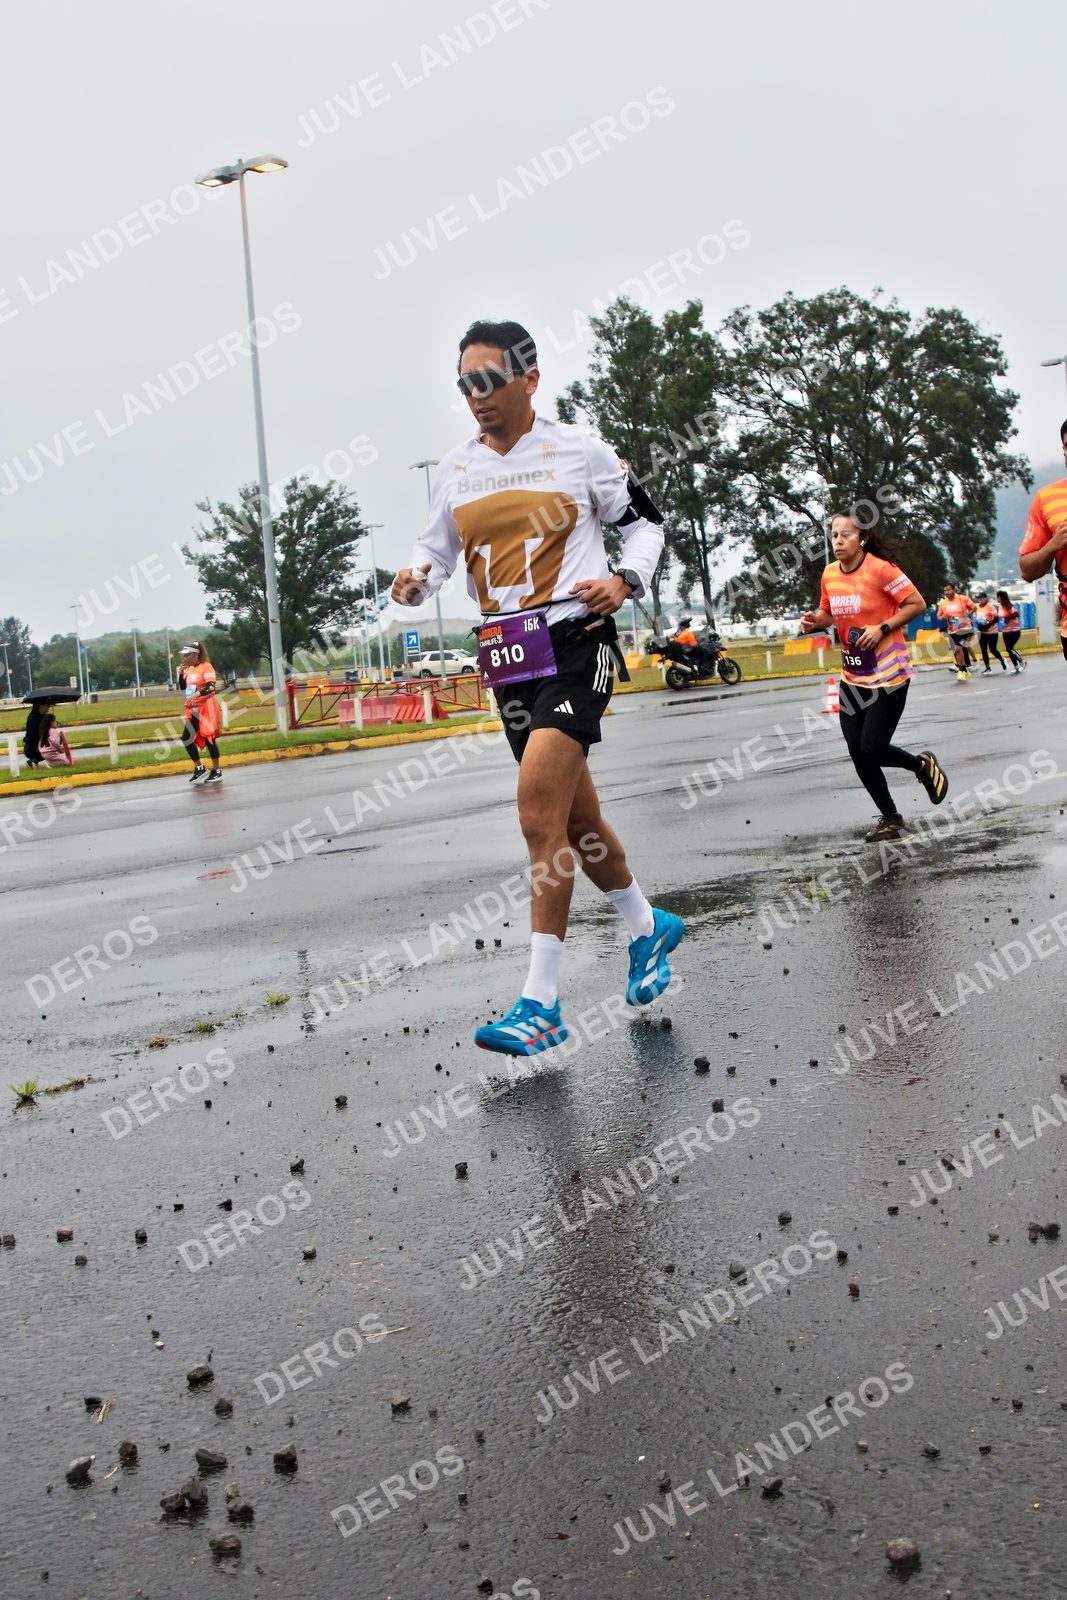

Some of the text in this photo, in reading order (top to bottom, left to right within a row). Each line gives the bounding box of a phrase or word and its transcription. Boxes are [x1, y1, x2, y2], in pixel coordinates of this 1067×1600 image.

[457, 468, 556, 495] Banamex
[523, 617, 540, 632] 15K
[490, 644, 525, 668] 810
[845, 655, 862, 666] 136
